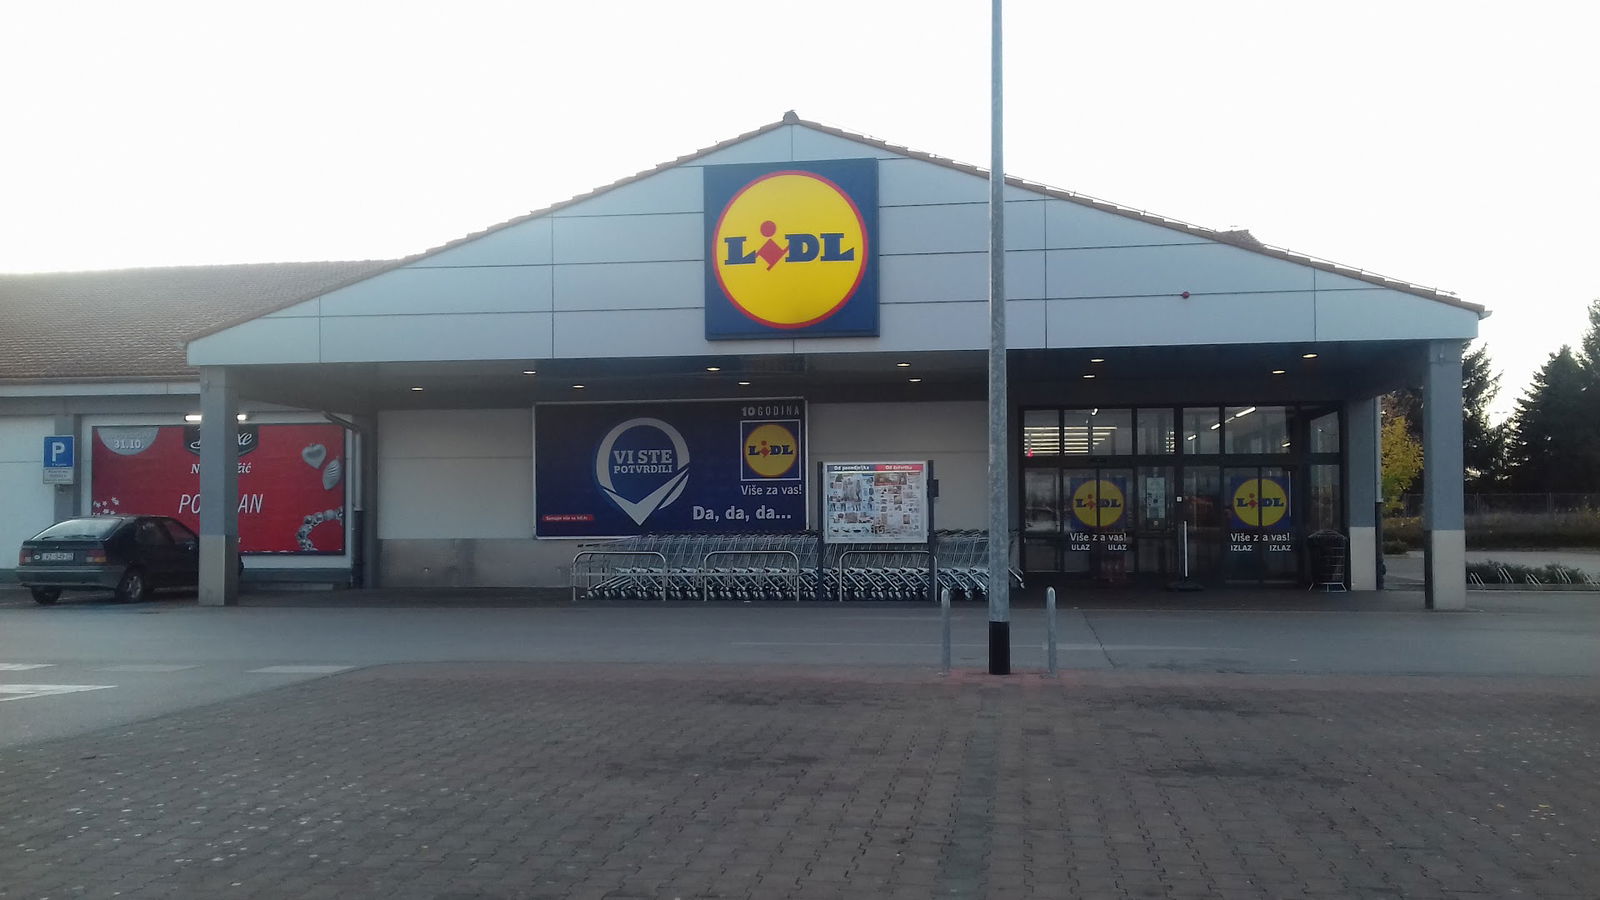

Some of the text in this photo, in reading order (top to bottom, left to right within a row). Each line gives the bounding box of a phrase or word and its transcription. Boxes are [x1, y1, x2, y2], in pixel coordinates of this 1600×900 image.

[724, 220, 855, 271] LIDL
[742, 406, 800, 417] 10 GODINA
[113, 439, 145, 449] 31.10.
[748, 440, 793, 458] LIDL
[51, 441, 65, 462] P
[613, 449, 673, 465] VI STE
[613, 464, 673, 474] POTVRDILI
[740, 484, 802, 495] Više za vas!
[692, 505, 792, 523] Da, da, da...
[1069, 532, 1090, 542] Više
[1108, 532, 1127, 542] vas!
[1230, 532, 1251, 542] Više
[1271, 532, 1290, 542] vas!
